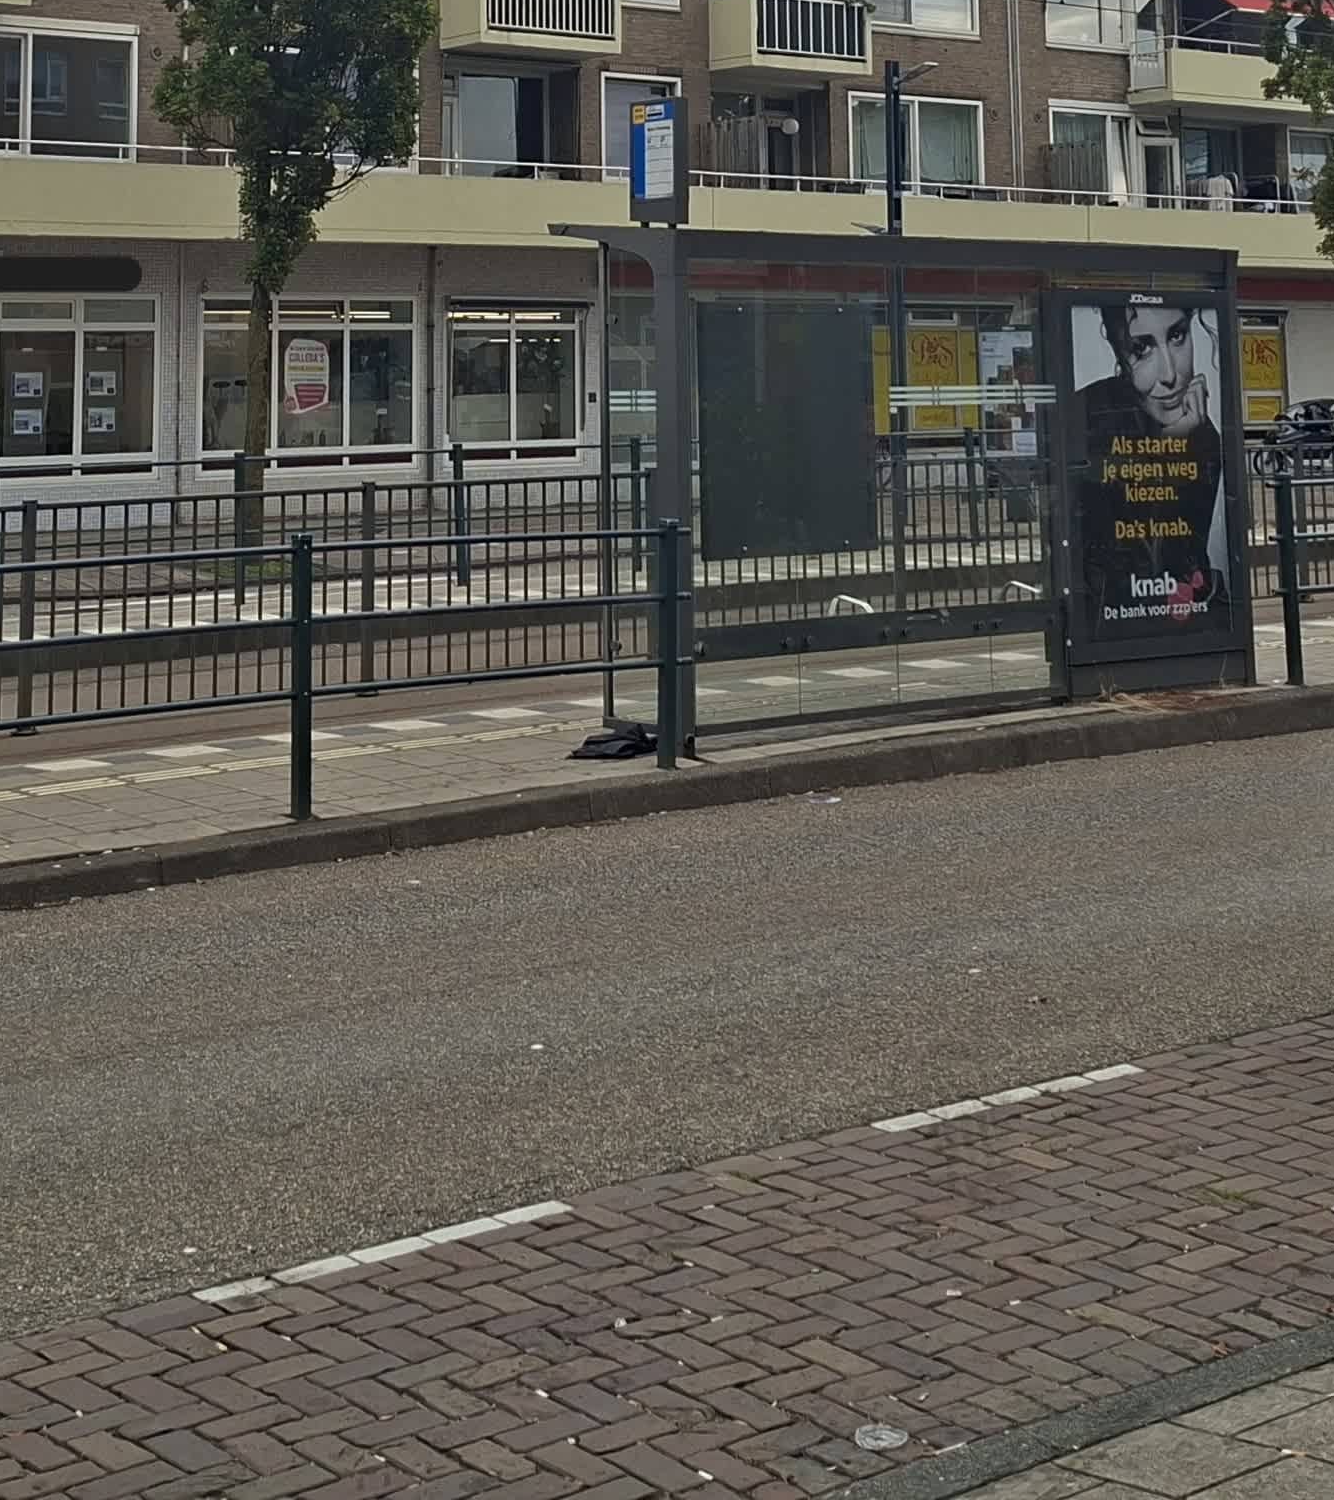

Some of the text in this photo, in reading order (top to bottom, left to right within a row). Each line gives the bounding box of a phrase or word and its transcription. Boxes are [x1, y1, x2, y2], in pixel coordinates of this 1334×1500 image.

[1112, 436, 1187, 454] Als starter
[1102, 459, 1198, 483] je eigen weg
[1125, 482, 1179, 502] kiezen.
[1115, 517, 1192, 539] Da's knab.
[1130, 571, 1178, 597] knab
[1104, 600, 1208, 620] De bank voor zzp'ers
